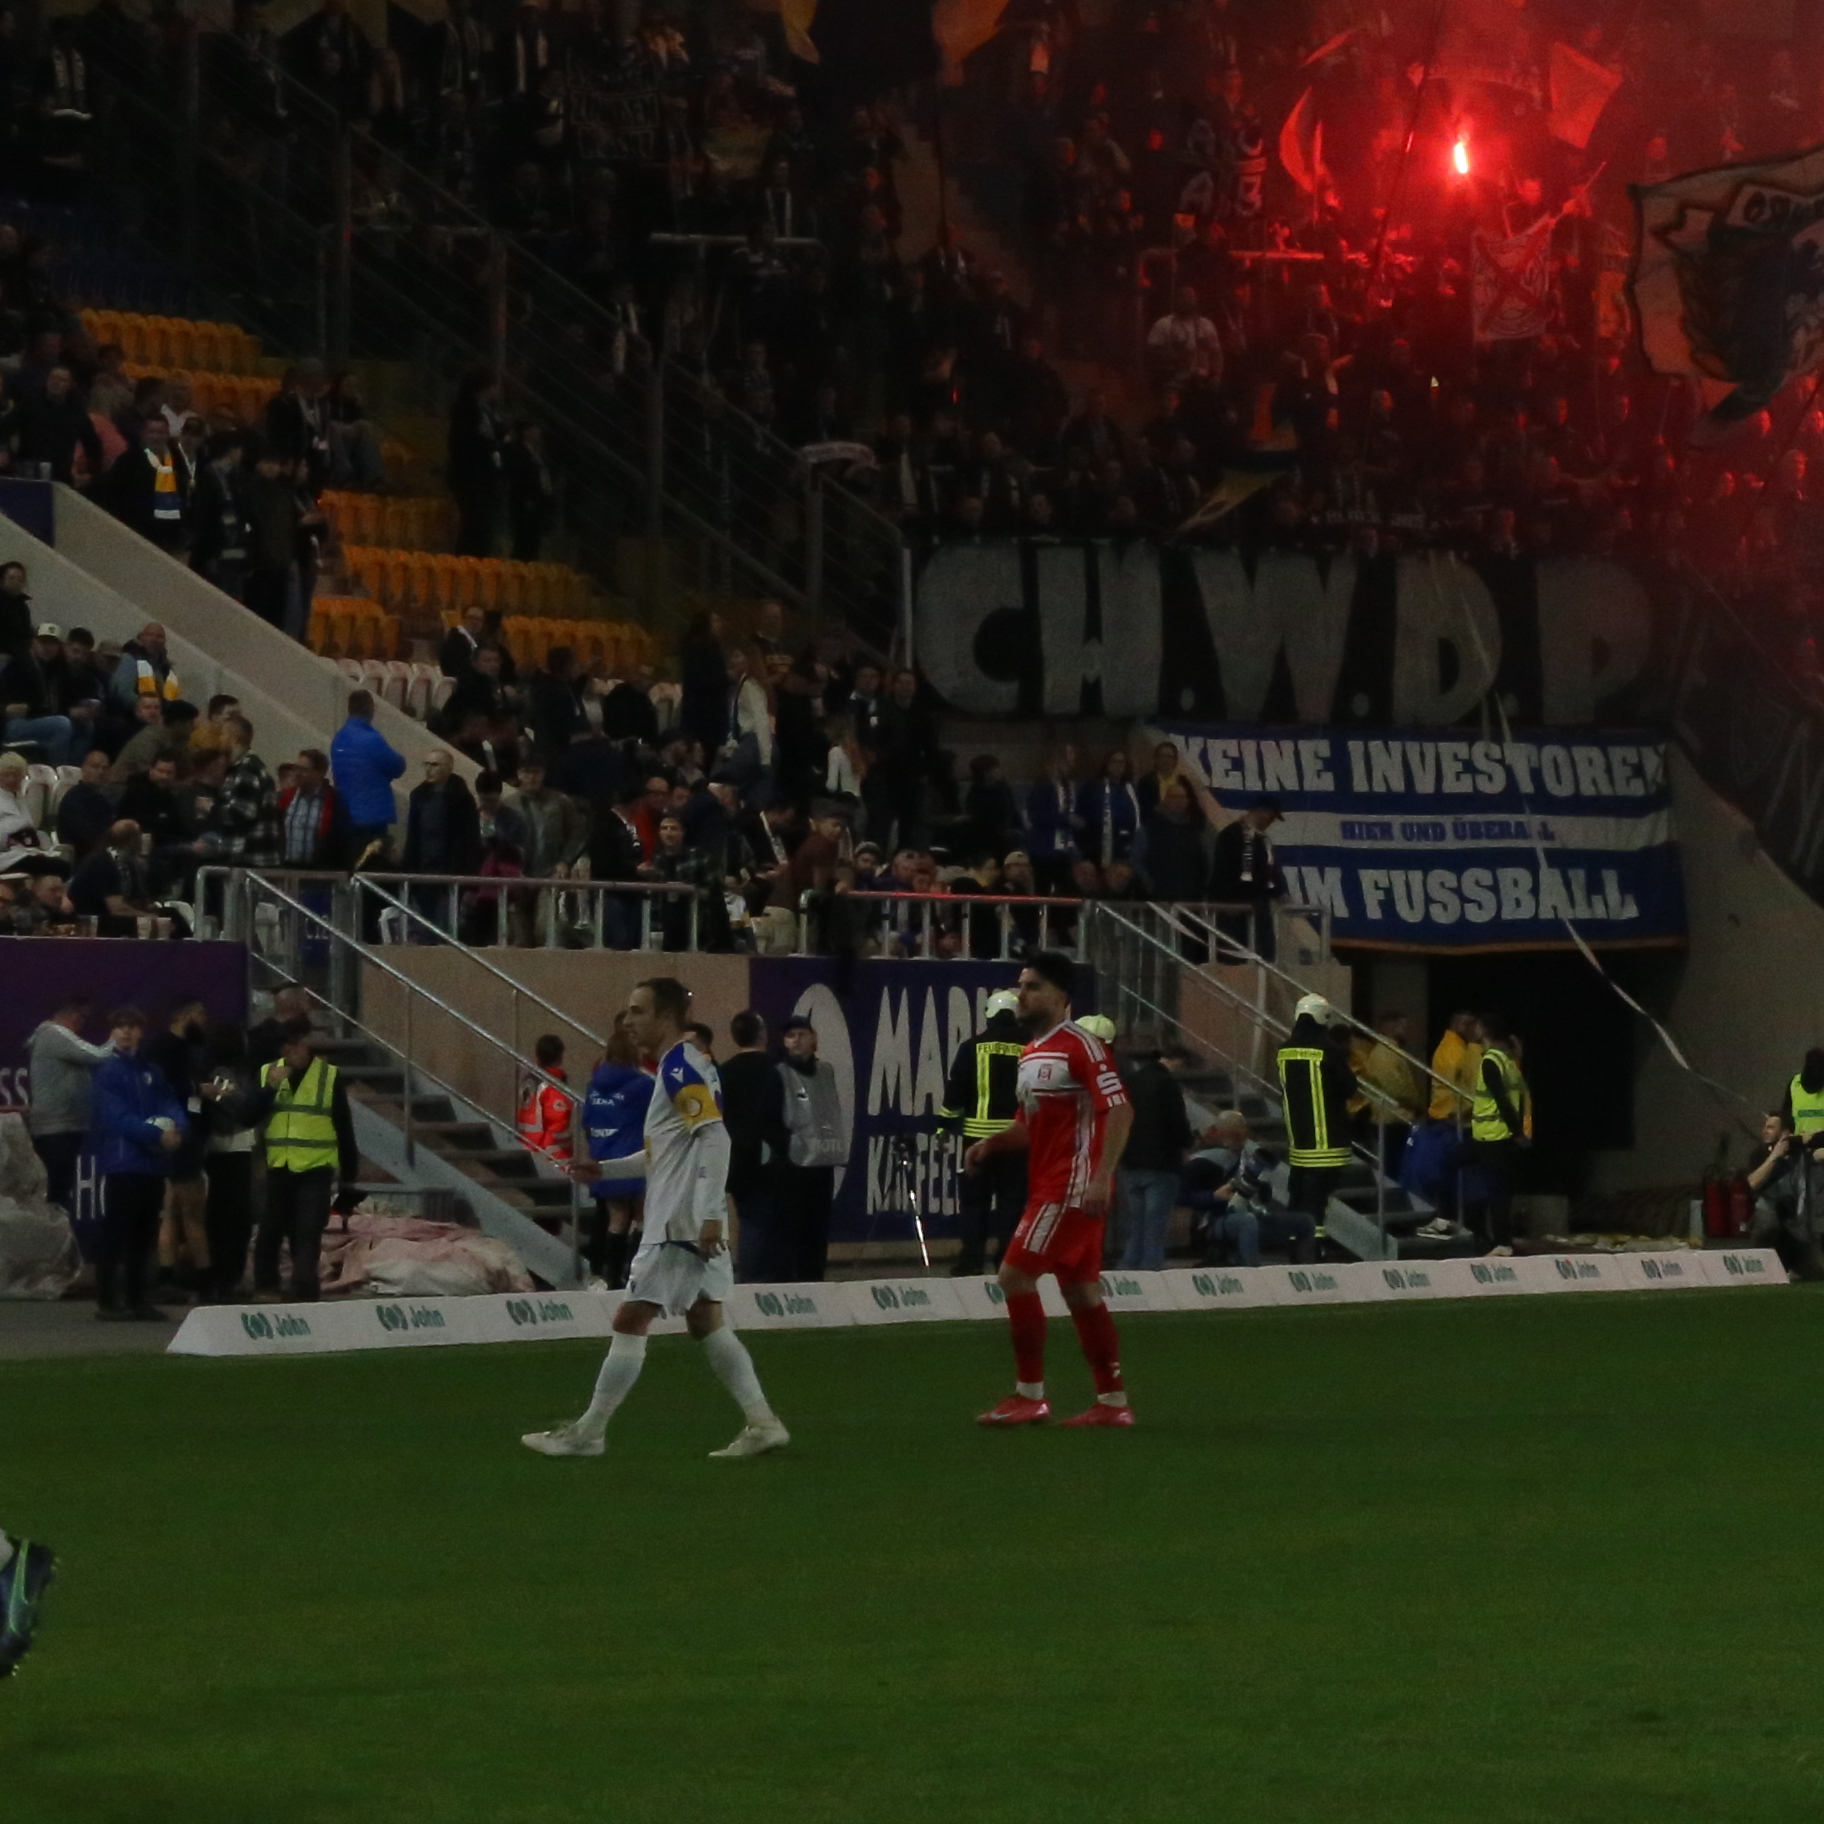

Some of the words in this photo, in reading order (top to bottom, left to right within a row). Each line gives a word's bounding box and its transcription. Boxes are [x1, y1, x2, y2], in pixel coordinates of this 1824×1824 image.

[1178, 737, 1335, 794] KEINE
[1348, 739, 1669, 797] INVESTOREN
[1340, 819, 1393, 842] HIER
[1401, 820, 1448, 843] UND
[1451, 814, 1556, 843] ÜBERAL
[1285, 866, 1346, 919] IM
[1363, 865, 1640, 924] FUSSBALL
[899, 1286, 931, 1306] John
[1112, 1276, 1143, 1296] John
[537, 1299, 574, 1322] John
[783, 1293, 818, 1314] John
[273, 1312, 312, 1337] John
[409, 1308, 446, 1329] John
